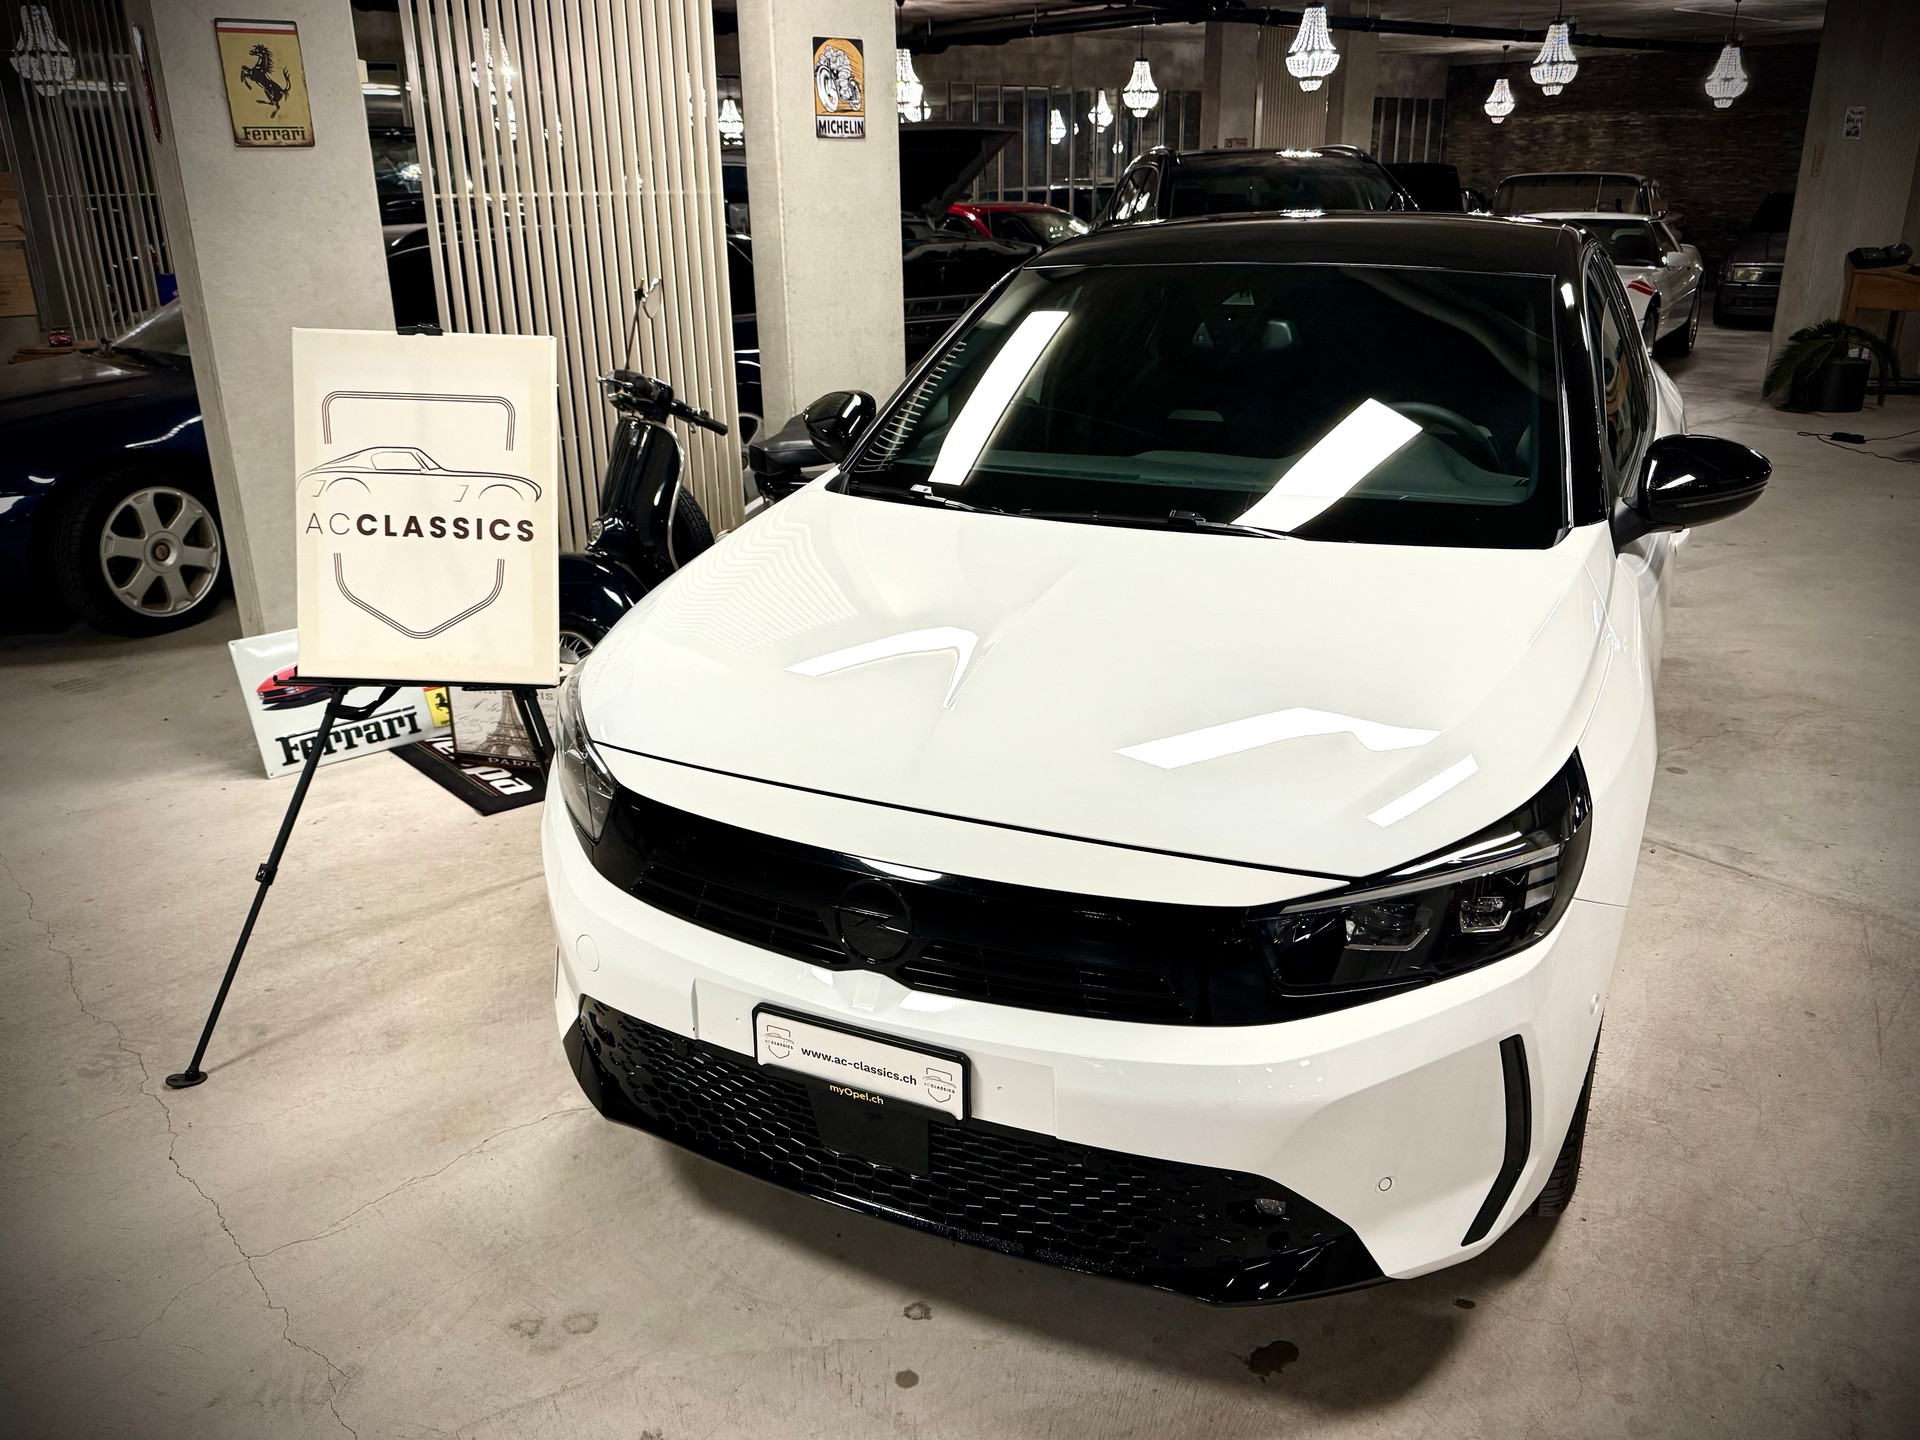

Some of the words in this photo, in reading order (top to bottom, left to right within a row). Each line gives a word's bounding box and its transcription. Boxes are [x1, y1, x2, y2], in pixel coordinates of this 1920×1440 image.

[241, 126, 306, 141] Ferrari
[818, 119, 864, 135] MICHELIN
[801, 1047, 917, 1086] www.ac-classics.ch
[829, 1084, 884, 1105] myOpel.ch
